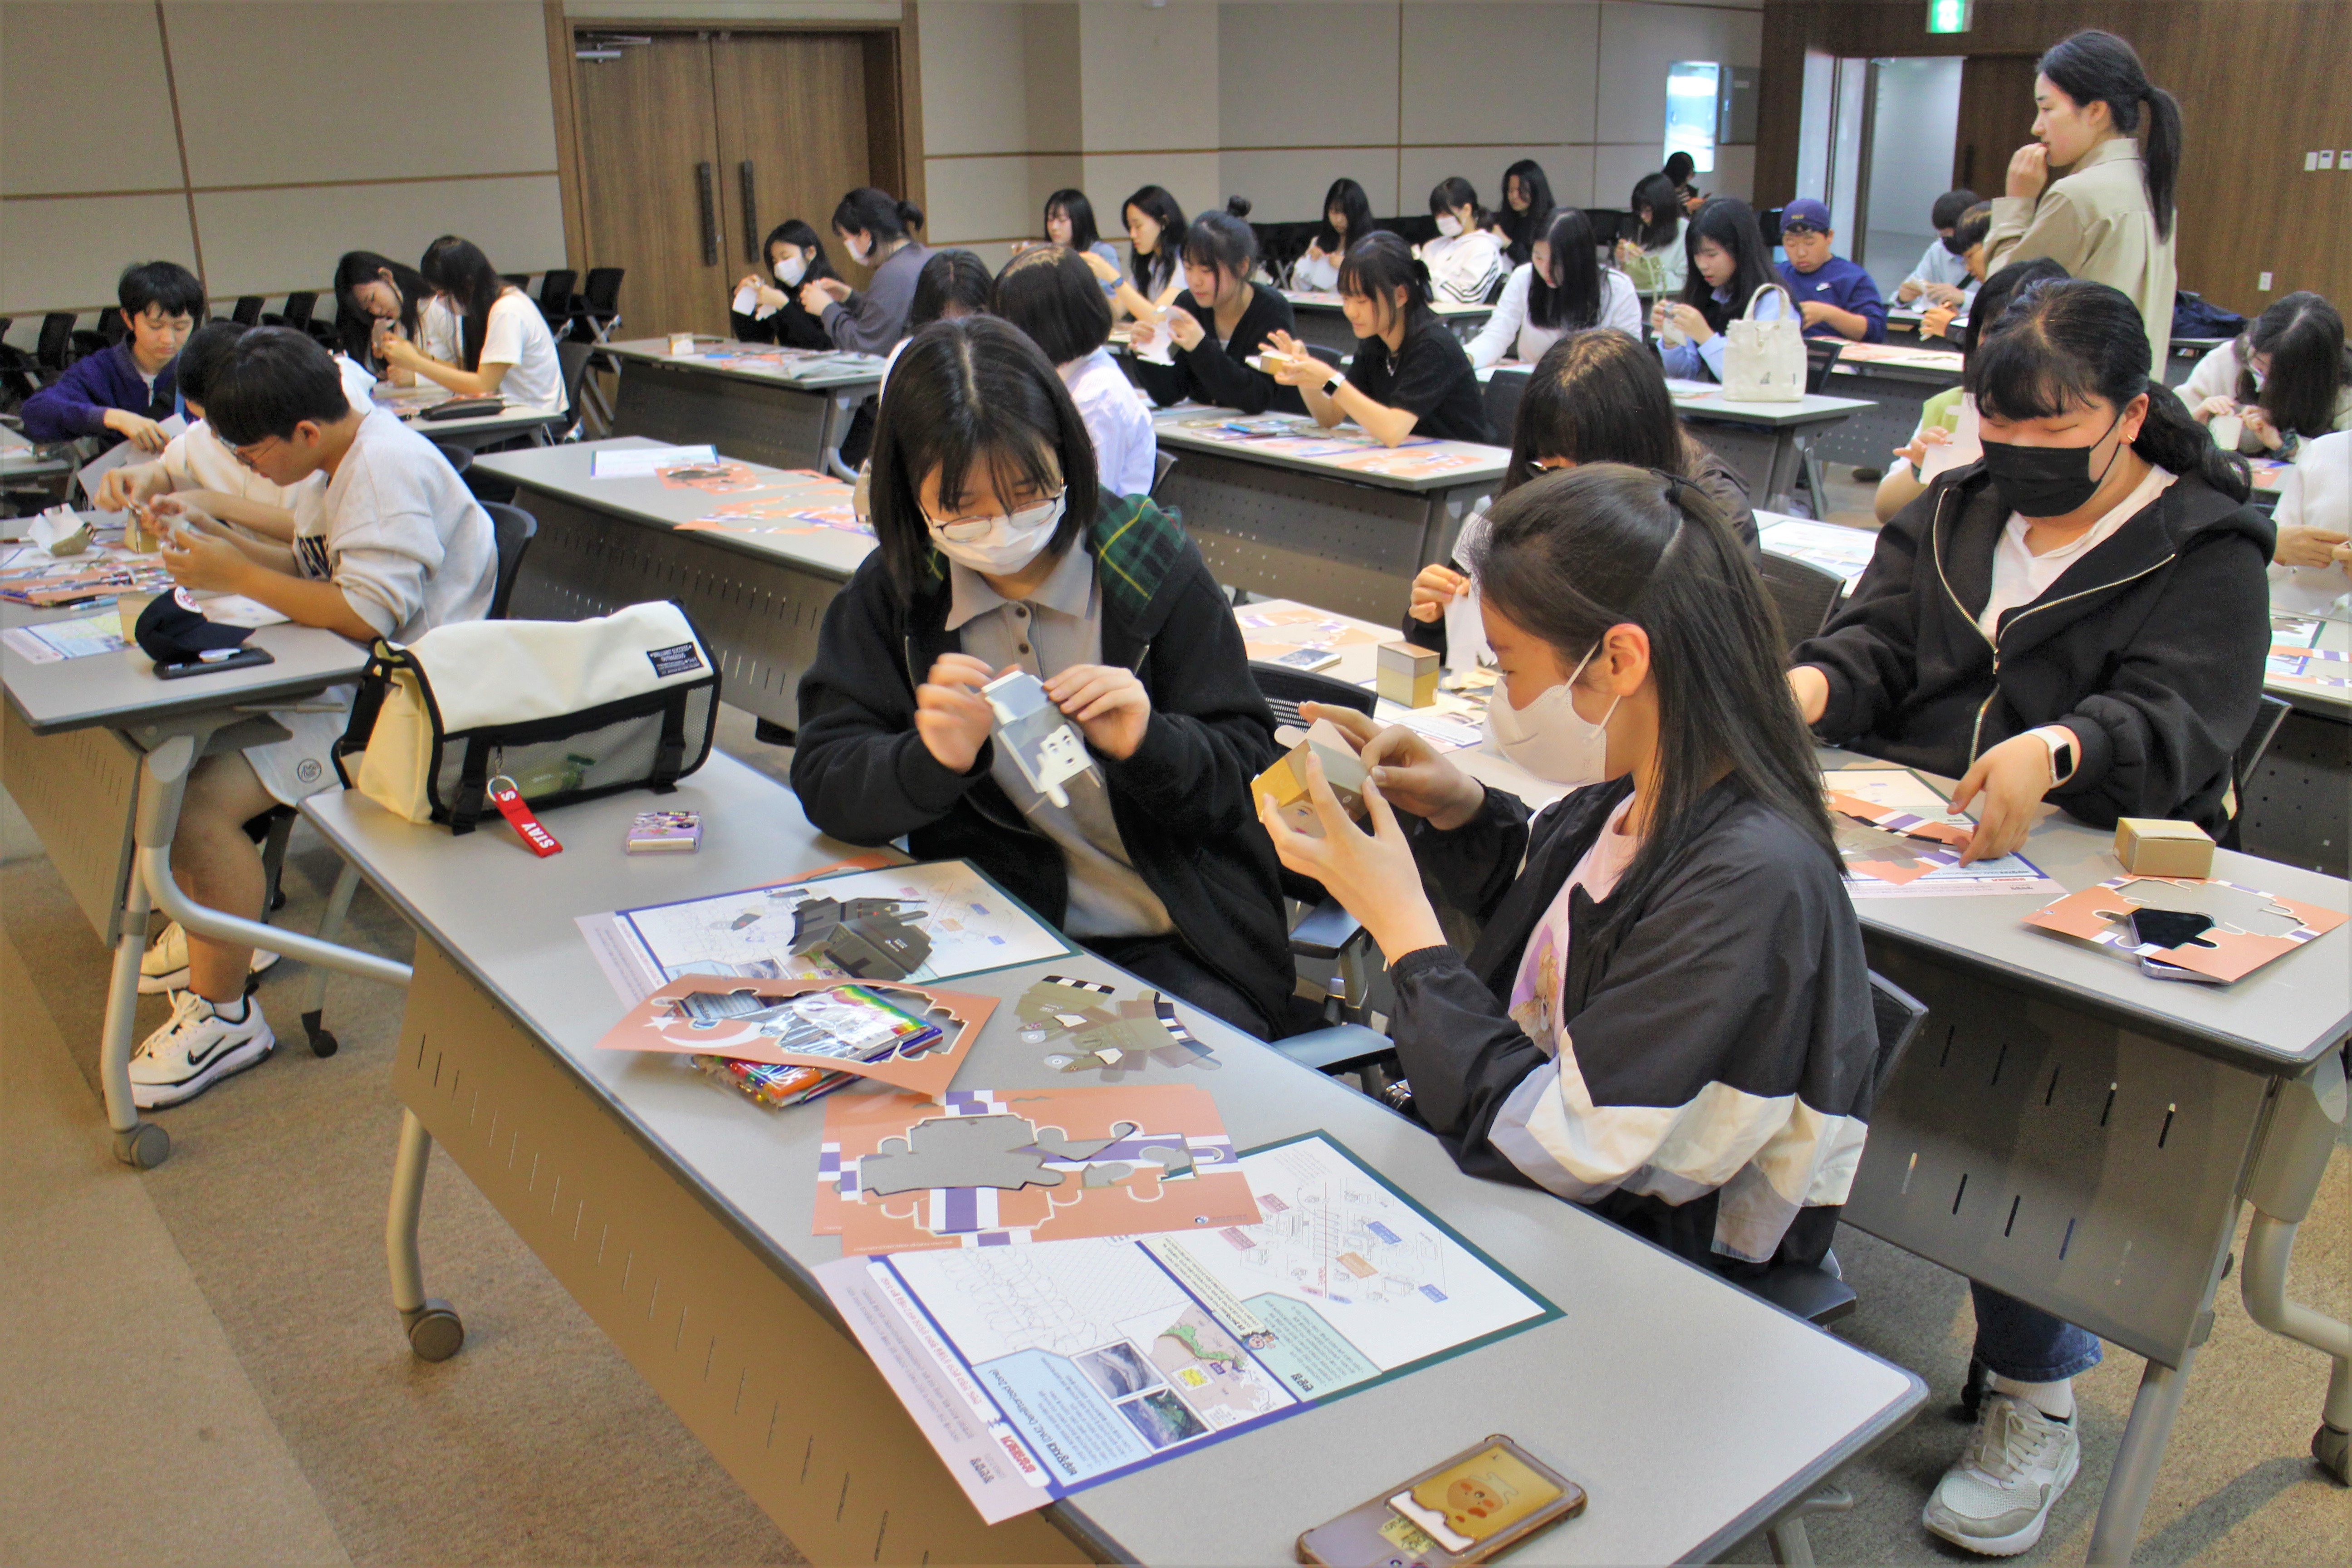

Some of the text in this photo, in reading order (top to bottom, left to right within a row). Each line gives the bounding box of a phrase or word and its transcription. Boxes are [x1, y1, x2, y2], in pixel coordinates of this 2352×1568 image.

[521, 822, 555, 849] STAY
[1289, 1371, 1314, 1393] 판문점
[999, 1434, 1037, 1474] 상상해보기
[1045, 1441, 1078, 1476] 비무장지대
